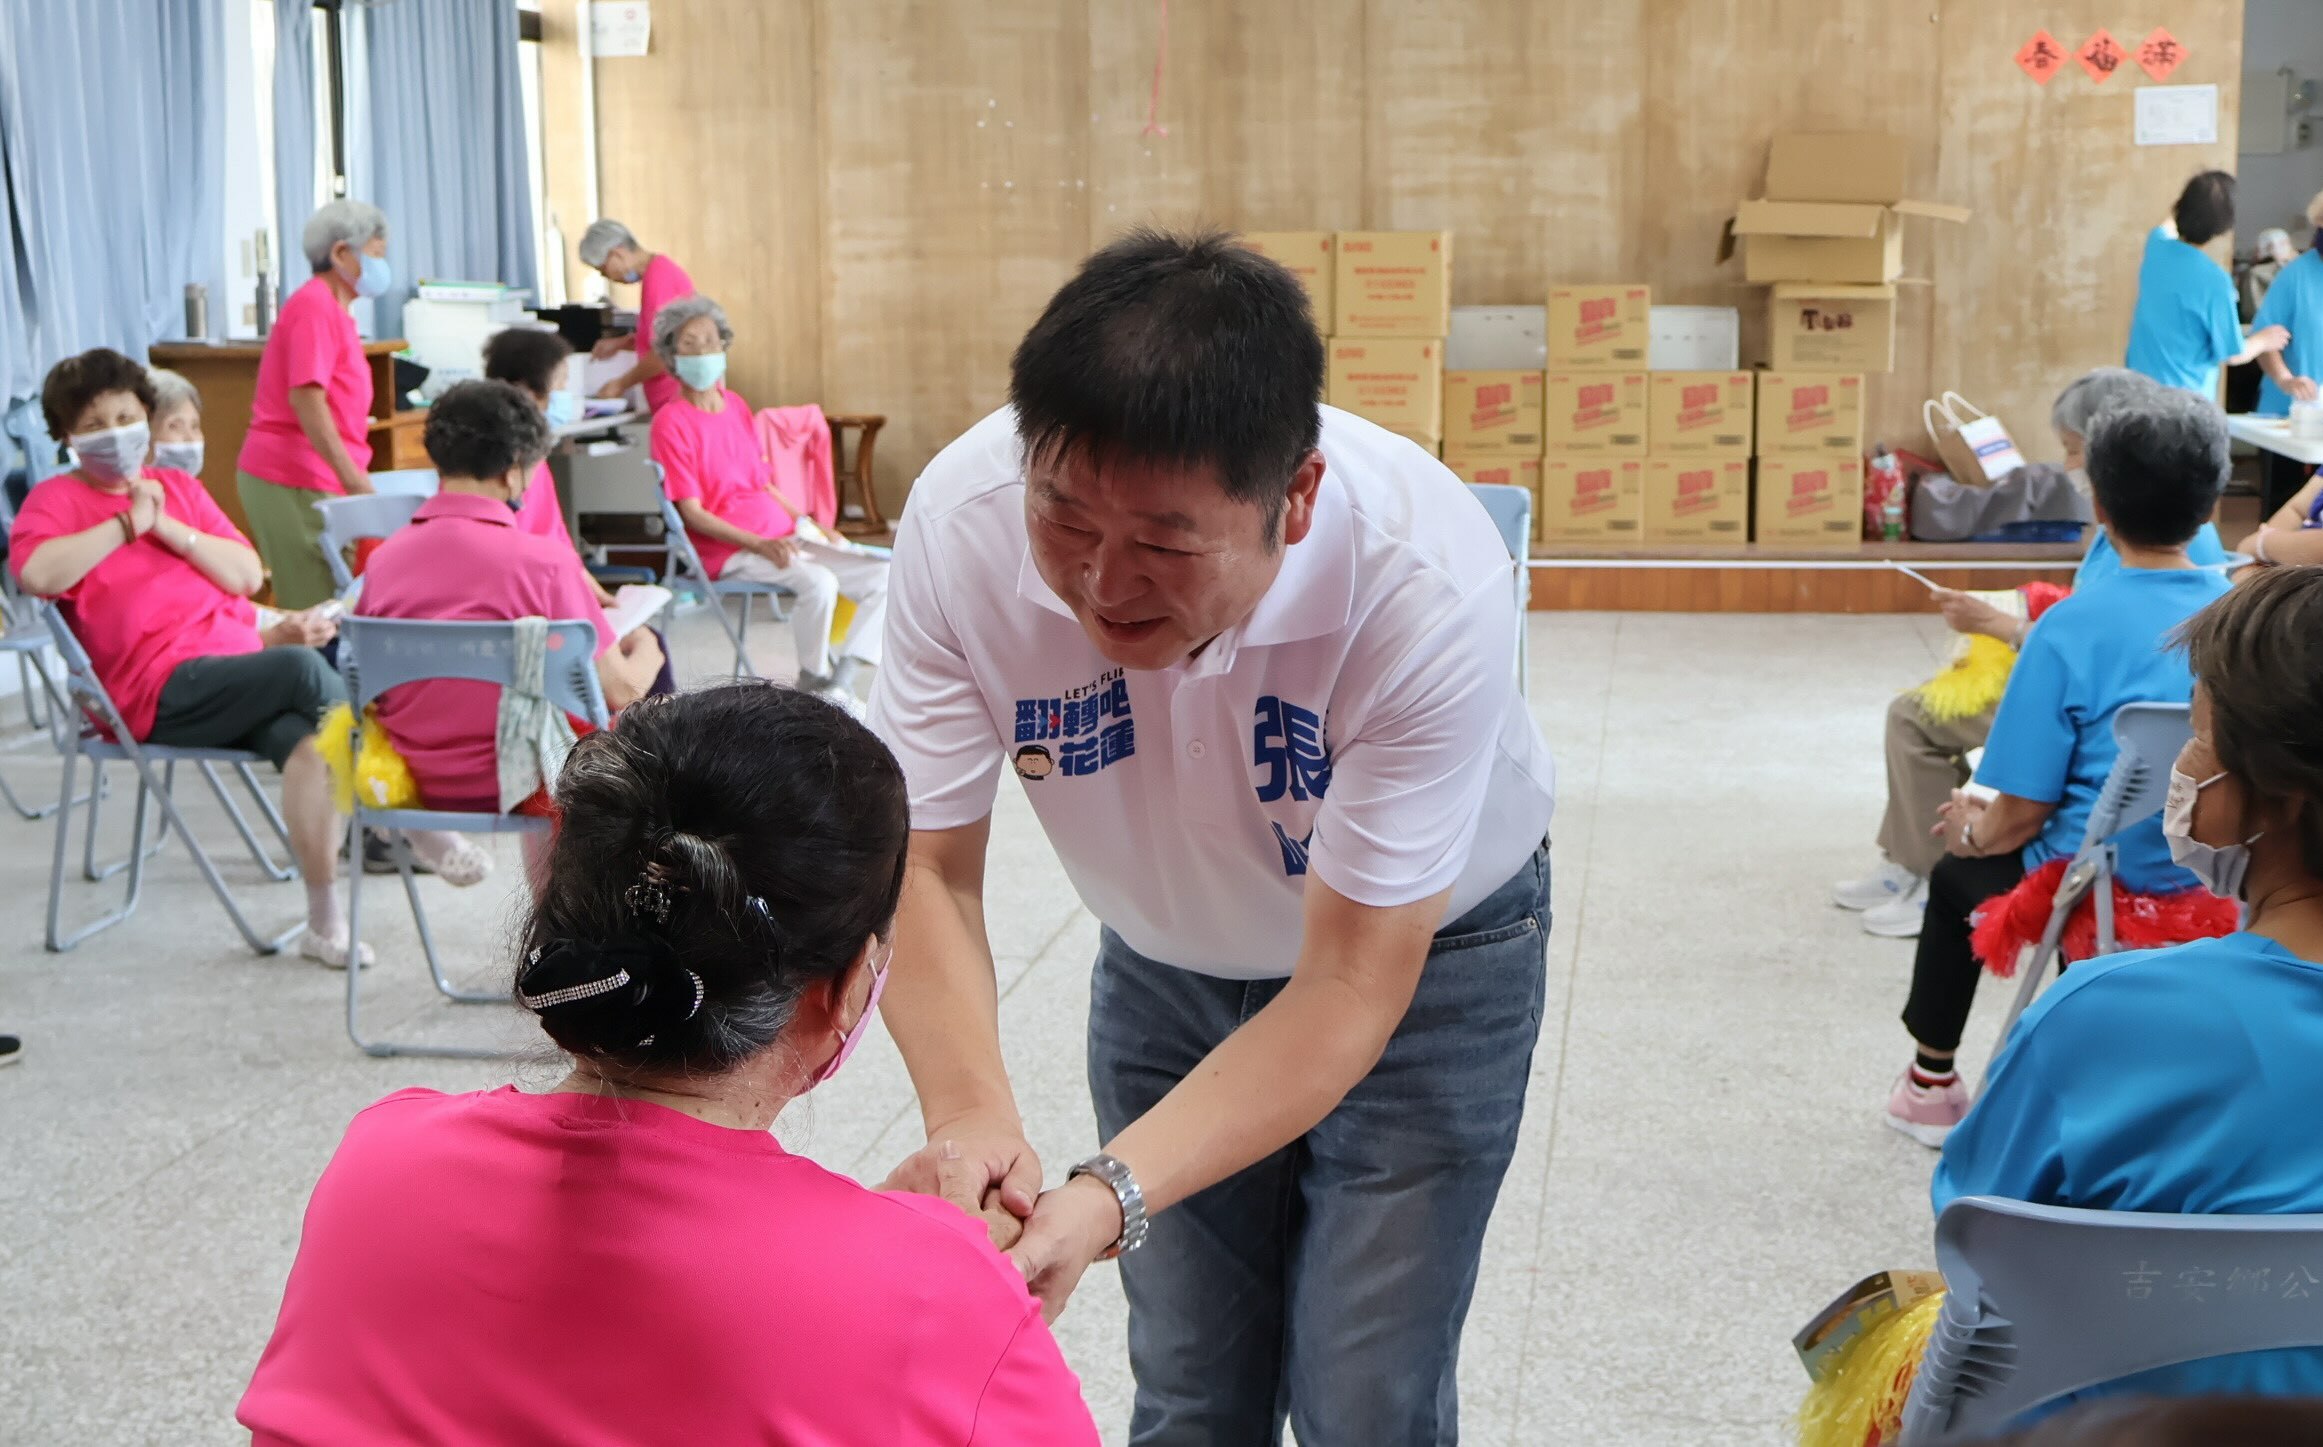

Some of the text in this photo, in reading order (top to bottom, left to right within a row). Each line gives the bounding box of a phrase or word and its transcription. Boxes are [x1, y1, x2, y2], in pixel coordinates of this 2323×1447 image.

[1014, 678, 1131, 743] 翻轉吧
[1064, 680, 1097, 700] LET'S
[1058, 718, 1135, 776] 花蓮
